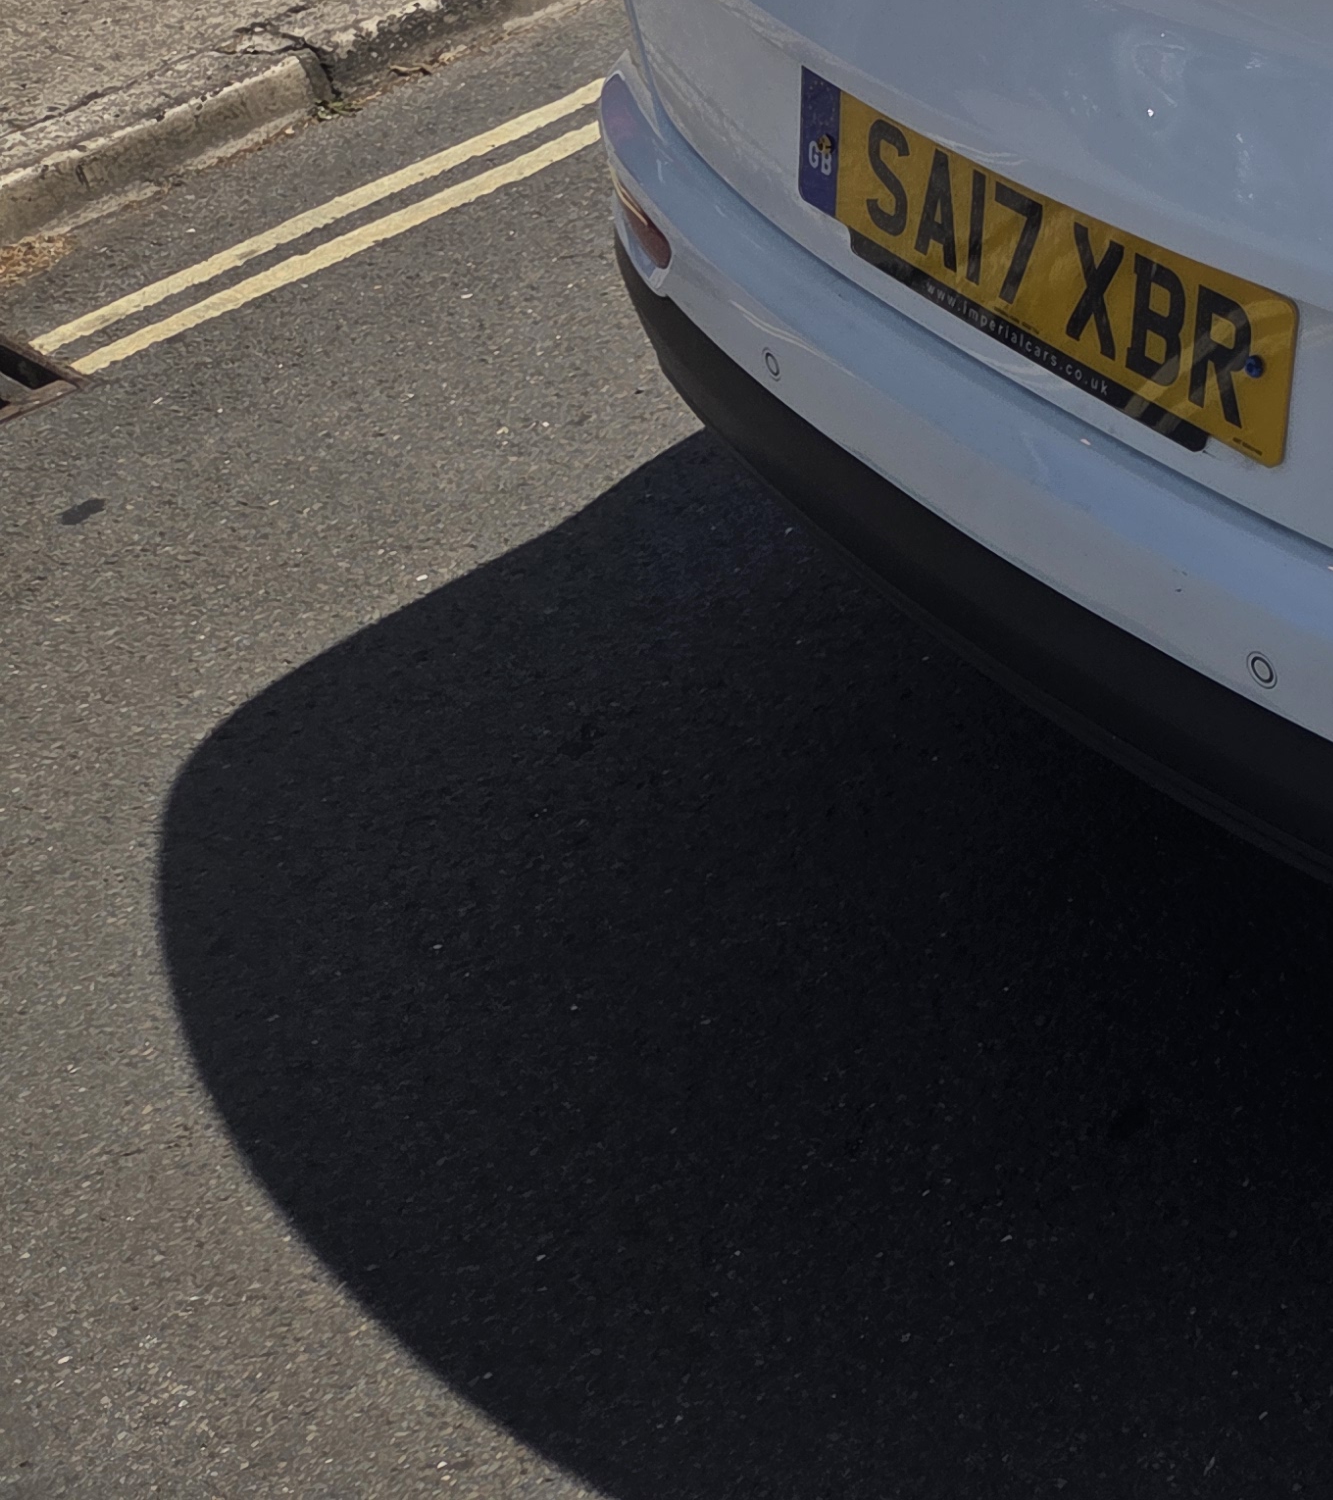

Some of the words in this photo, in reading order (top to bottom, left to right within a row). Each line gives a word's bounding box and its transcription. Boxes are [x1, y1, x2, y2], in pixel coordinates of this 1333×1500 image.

[808, 138, 832, 176] GB
[866, 119, 1043, 305] SA17
[1065, 221, 1252, 429] XBR
[925, 281, 1110, 396] www.imperialcars.co.uk
